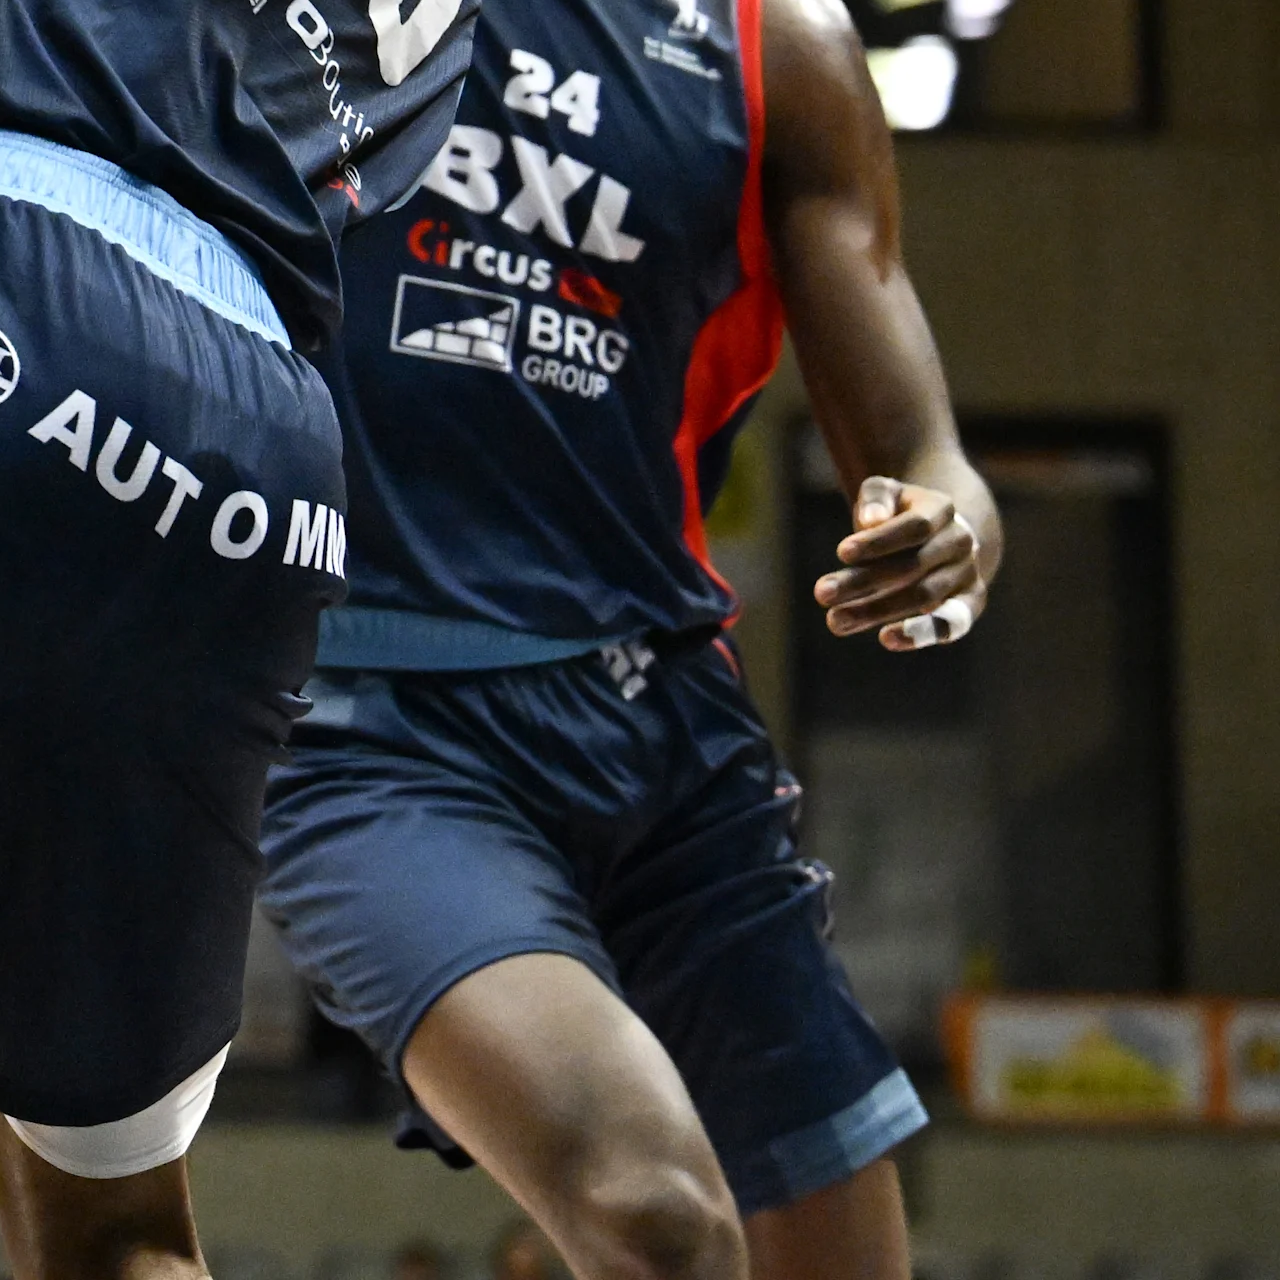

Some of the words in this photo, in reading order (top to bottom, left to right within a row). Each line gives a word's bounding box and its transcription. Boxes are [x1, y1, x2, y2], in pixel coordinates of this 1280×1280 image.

[504, 48, 601, 137] 24
[421, 124, 646, 262] BXL
[407, 218, 553, 292] Circus
[527, 304, 631, 373] BRG
[521, 354, 610, 402] GROUP
